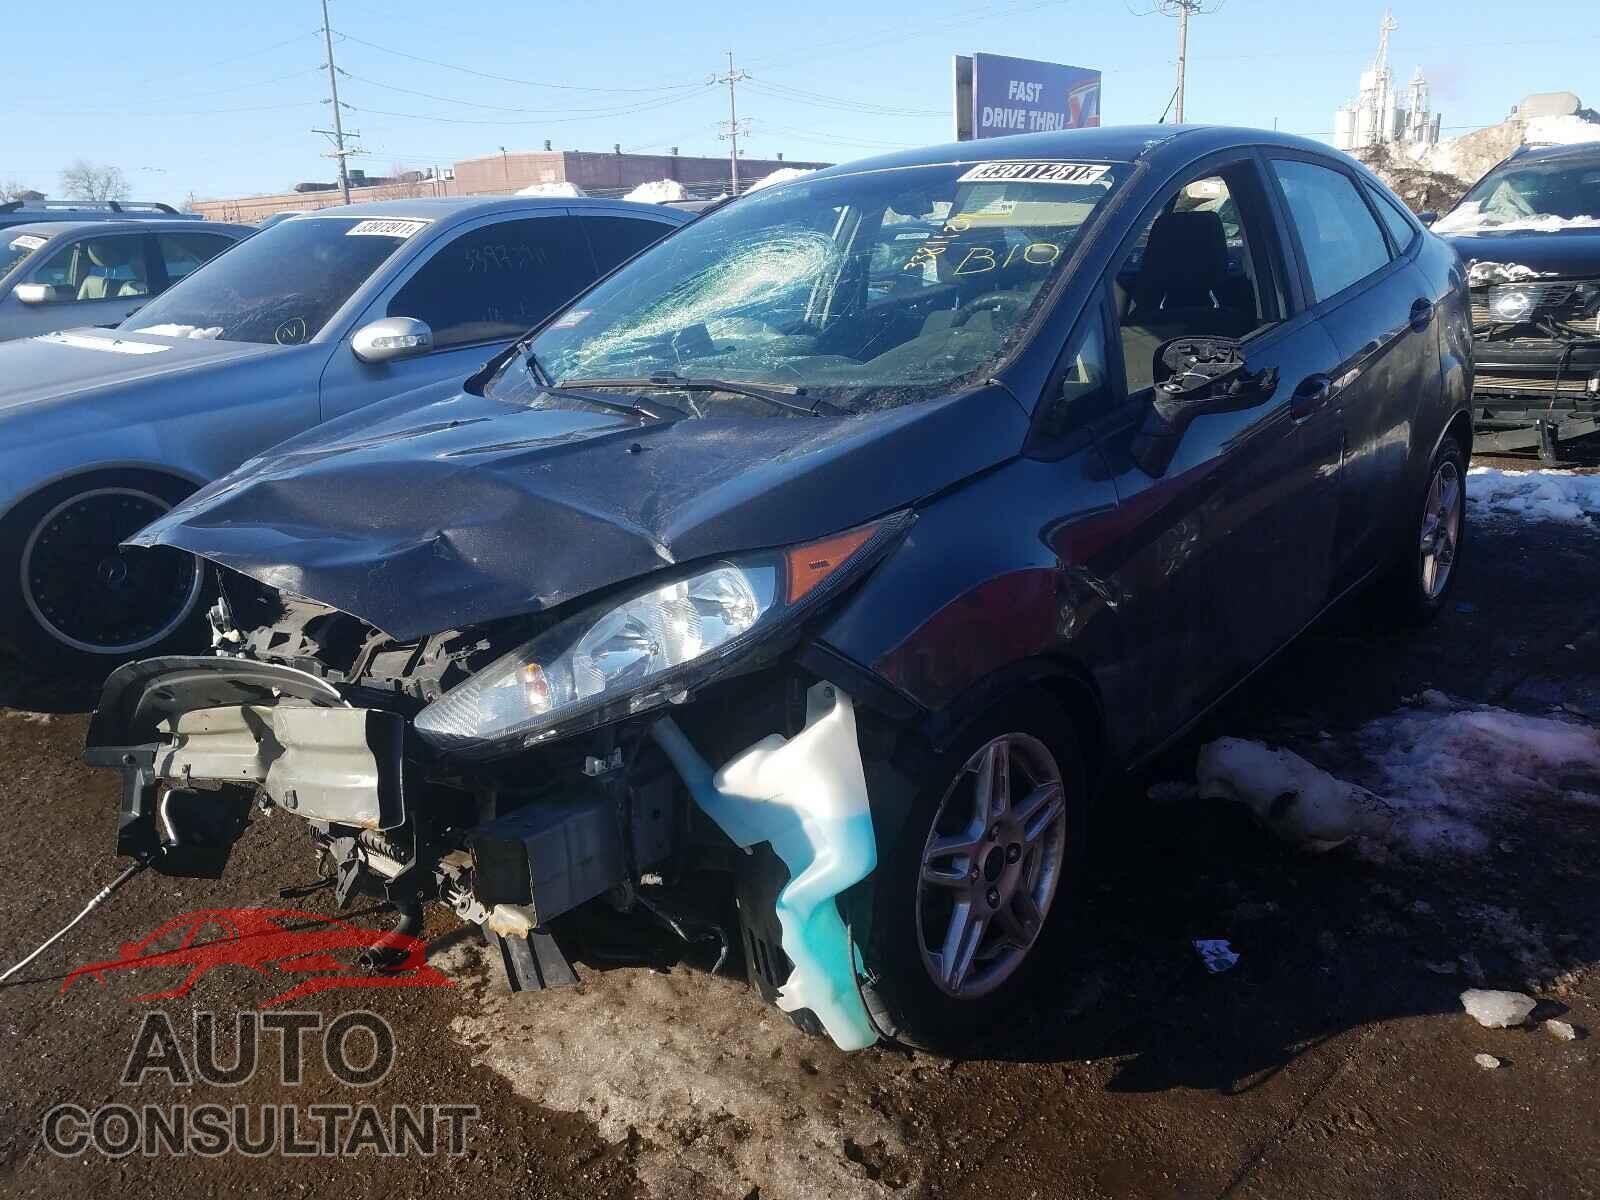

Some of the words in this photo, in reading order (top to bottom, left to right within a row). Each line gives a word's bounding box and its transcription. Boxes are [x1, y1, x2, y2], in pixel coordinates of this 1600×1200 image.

[1008, 80, 1043, 102] FAST
[982, 106, 1026, 129] DRIVE
[1028, 110, 1065, 131] THRU
